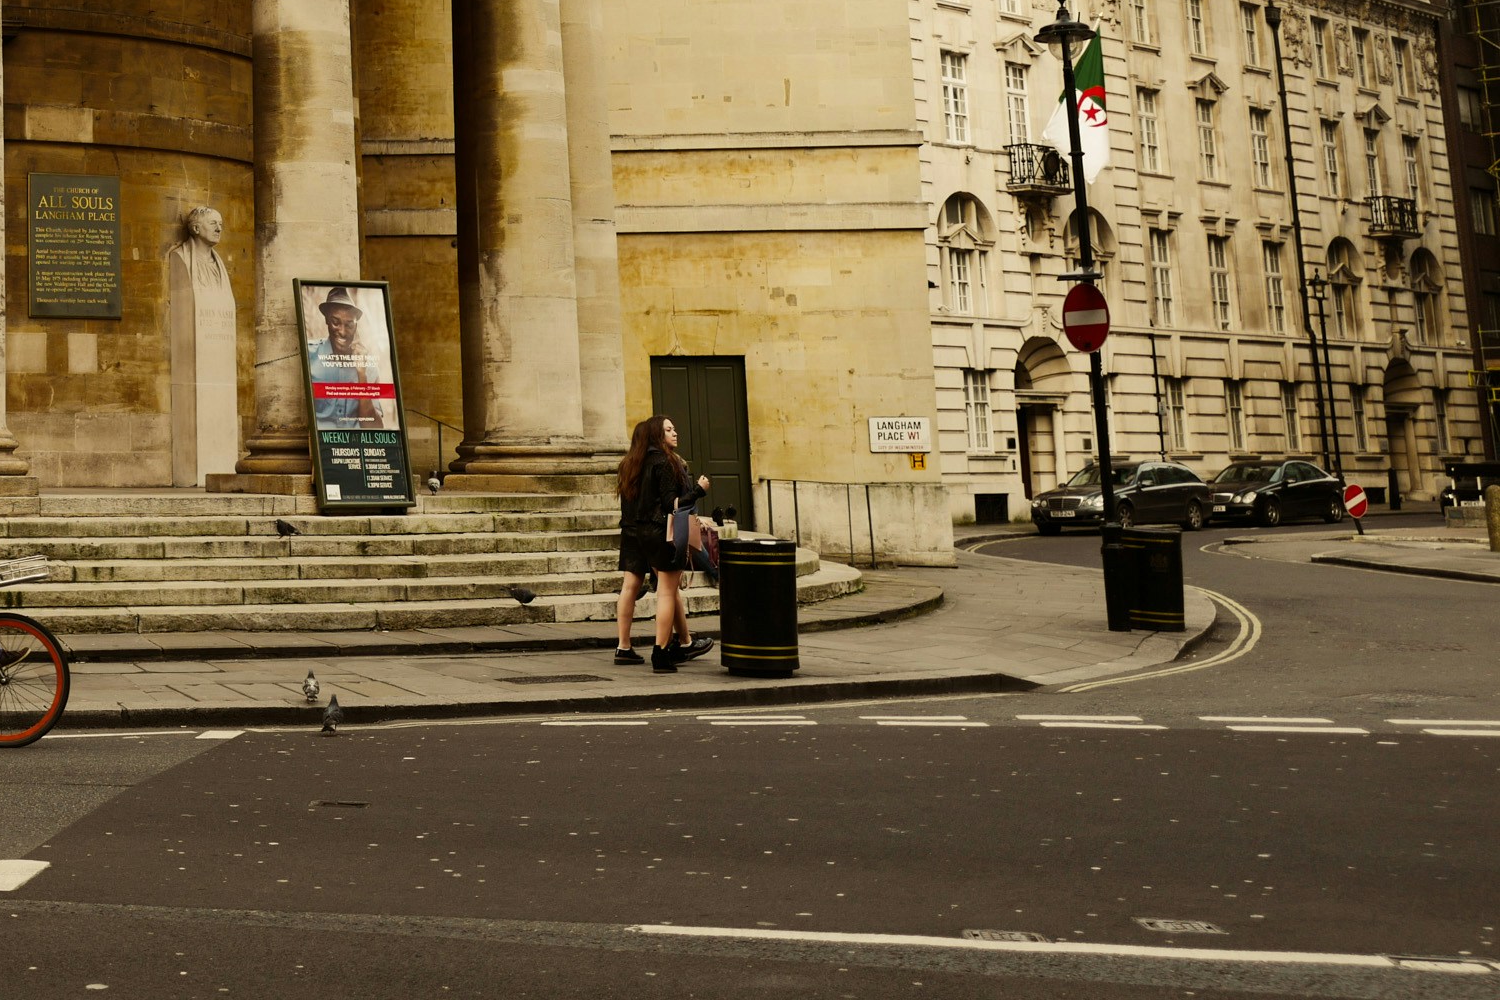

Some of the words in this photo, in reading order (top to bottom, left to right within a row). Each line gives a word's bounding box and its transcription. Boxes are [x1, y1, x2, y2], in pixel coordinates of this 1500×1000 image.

[39, 195, 67, 208] ALL
[72, 196, 113, 210] SOULS
[35, 211, 85, 220] LANGHAM
[88, 212, 116, 221] PLACE
[877, 421, 921, 430] LANGHAM
[322, 432, 350, 443] WEEKLY
[361, 433, 373, 443] ALL
[374, 433, 396, 443] SOULS
[878, 432, 904, 440] PLACE
[908, 432, 919, 440] W1
[331, 448, 360, 456] THURSDAYS
[913, 454, 924, 468] H
